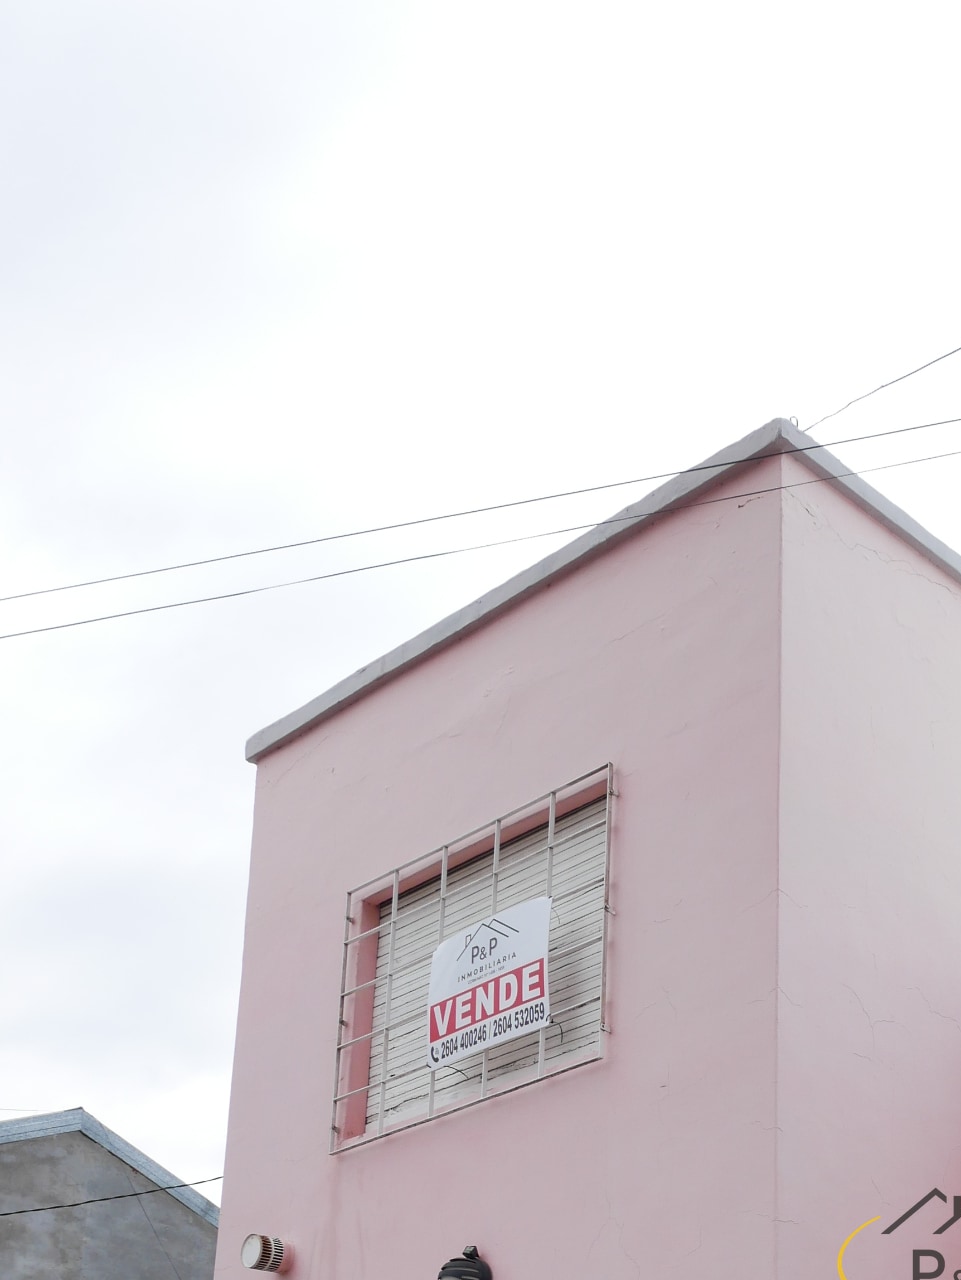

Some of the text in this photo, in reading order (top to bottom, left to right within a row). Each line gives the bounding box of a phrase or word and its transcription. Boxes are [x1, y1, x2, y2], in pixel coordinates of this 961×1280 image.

[457, 952, 517, 983] INMOBILIARIA
[471, 937, 498, 964] P&P
[433, 962, 541, 1037] VENDE
[441, 1036, 458, 1059] 2604
[460, 1024, 487, 1050] 400246
[493, 1014, 512, 1038] 2604
[514, 1002, 545, 1029] 532059
